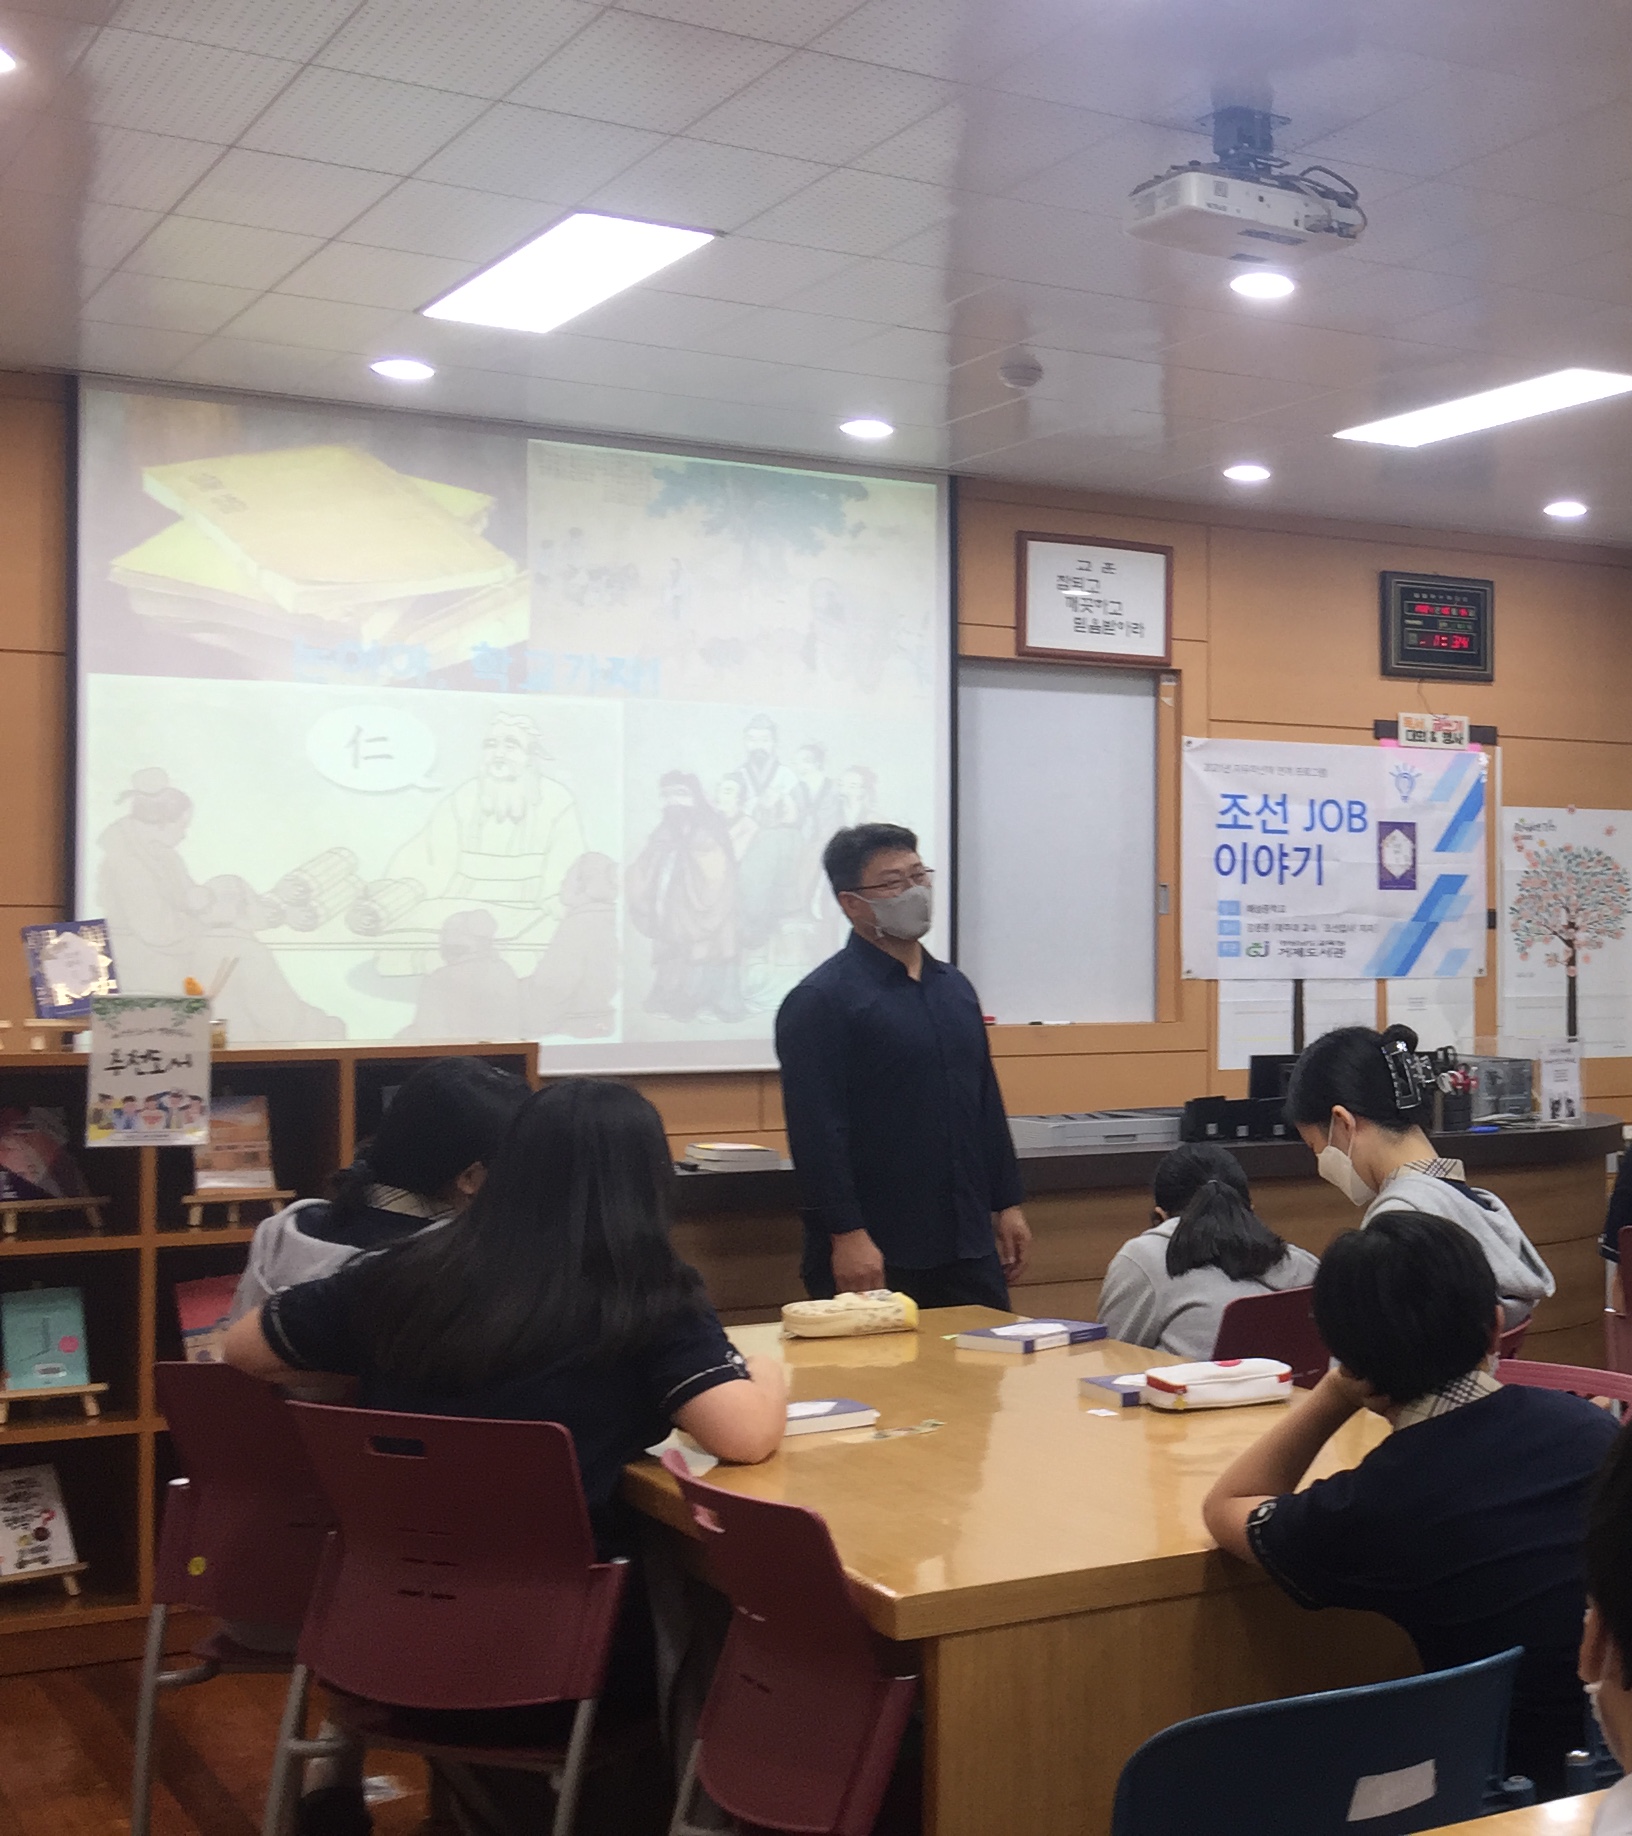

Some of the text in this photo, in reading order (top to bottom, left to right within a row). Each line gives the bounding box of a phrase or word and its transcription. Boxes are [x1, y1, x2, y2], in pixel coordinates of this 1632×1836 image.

[1065, 596, 1123, 616] 깨끗하고
[345, 725, 395, 768] 仁
[1215, 793, 1369, 835] 조선 JOB
[1213, 841, 1323, 886] 이야기
[1277, 947, 1346, 959] 거제도서관
